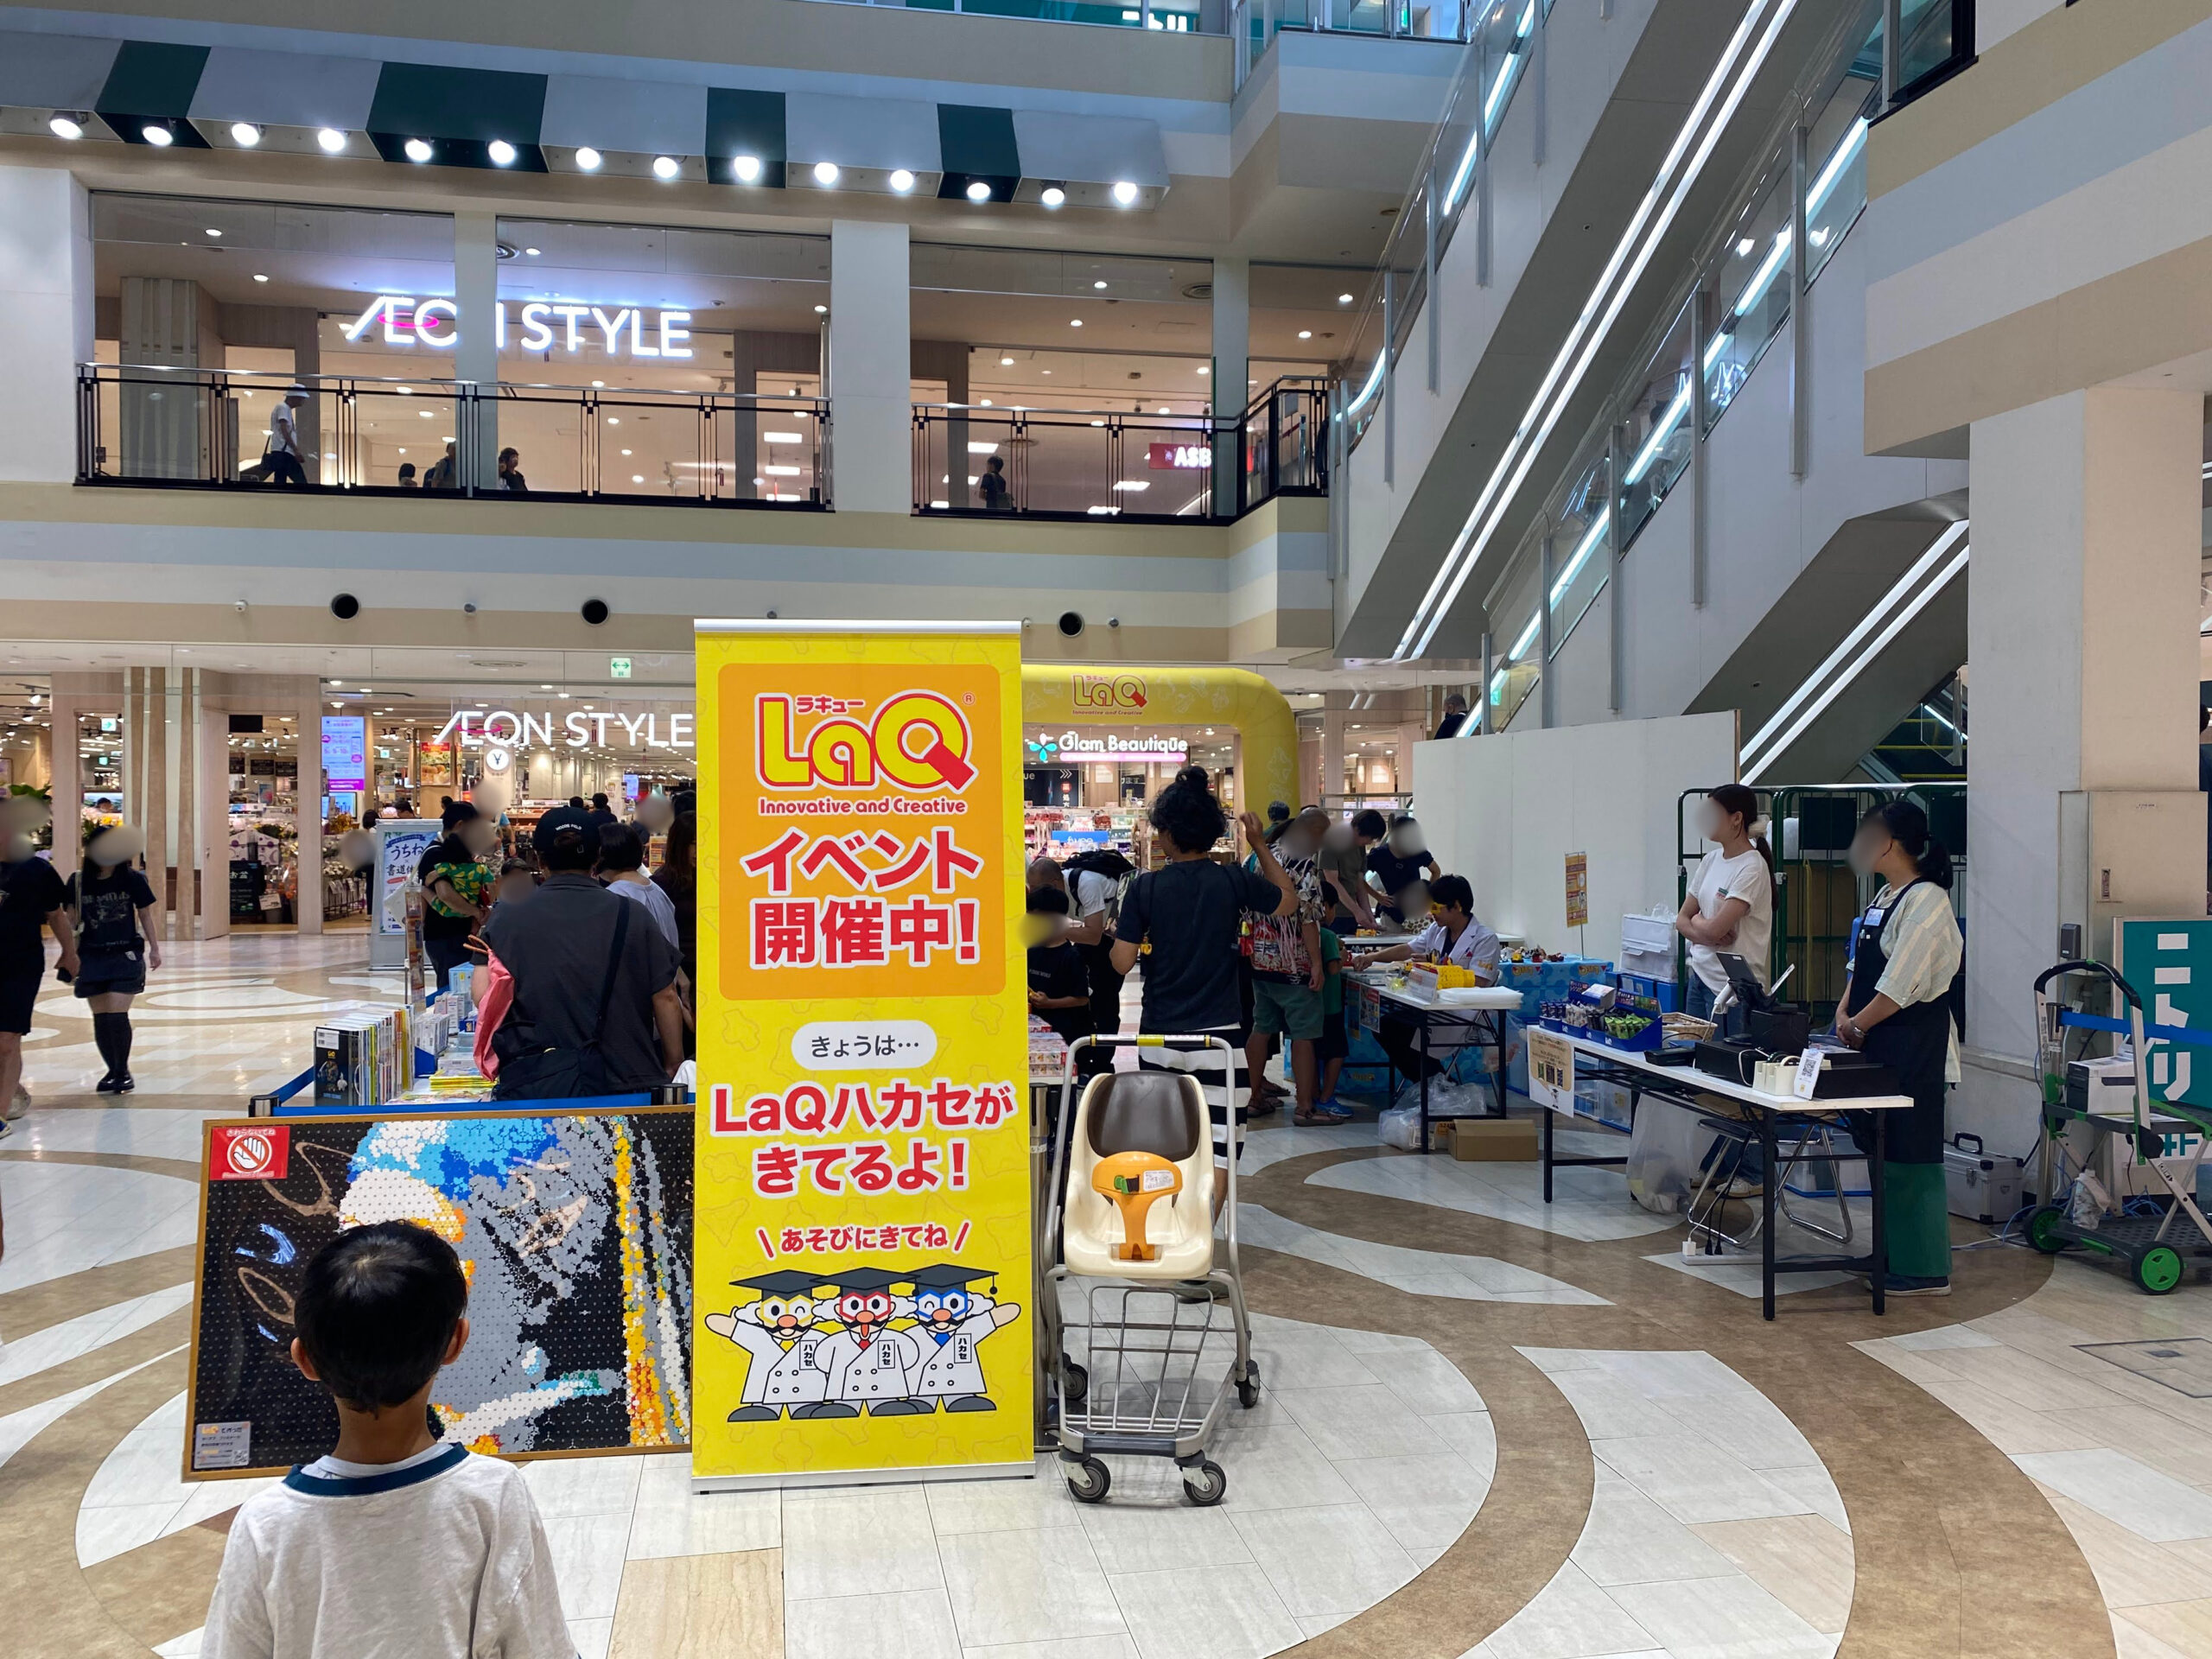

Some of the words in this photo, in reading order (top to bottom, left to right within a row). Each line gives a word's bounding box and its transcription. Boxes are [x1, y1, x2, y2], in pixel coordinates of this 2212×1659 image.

[346, 296, 505, 347] AEO
[520, 302, 692, 358] STYLE
[796, 696, 864, 714] ラキュー
[1073, 674, 1147, 708] LaQ
[564, 711, 695, 747] STYLE
[758, 692, 976, 791] LaQ
[1059, 734, 1105, 752] Glam
[1109, 734, 1188, 754] Beautique
[760, 798, 851, 814] Innovative
[855, 798, 890, 814] and
[893, 798, 966, 814] Creative
[744, 830, 980, 892] イベント
[754, 899, 976, 965] 開催中!
[715, 1082, 1014, 1133] LaQハカセが
[757, 1142, 965, 1193] きてるよ!
[780, 1224, 948, 1253] あそびにきてね
[803, 1343, 814, 1368] ハカセ
[881, 1343, 892, 1366] ハカセ
[957, 1336, 968, 1361] ハカセ
